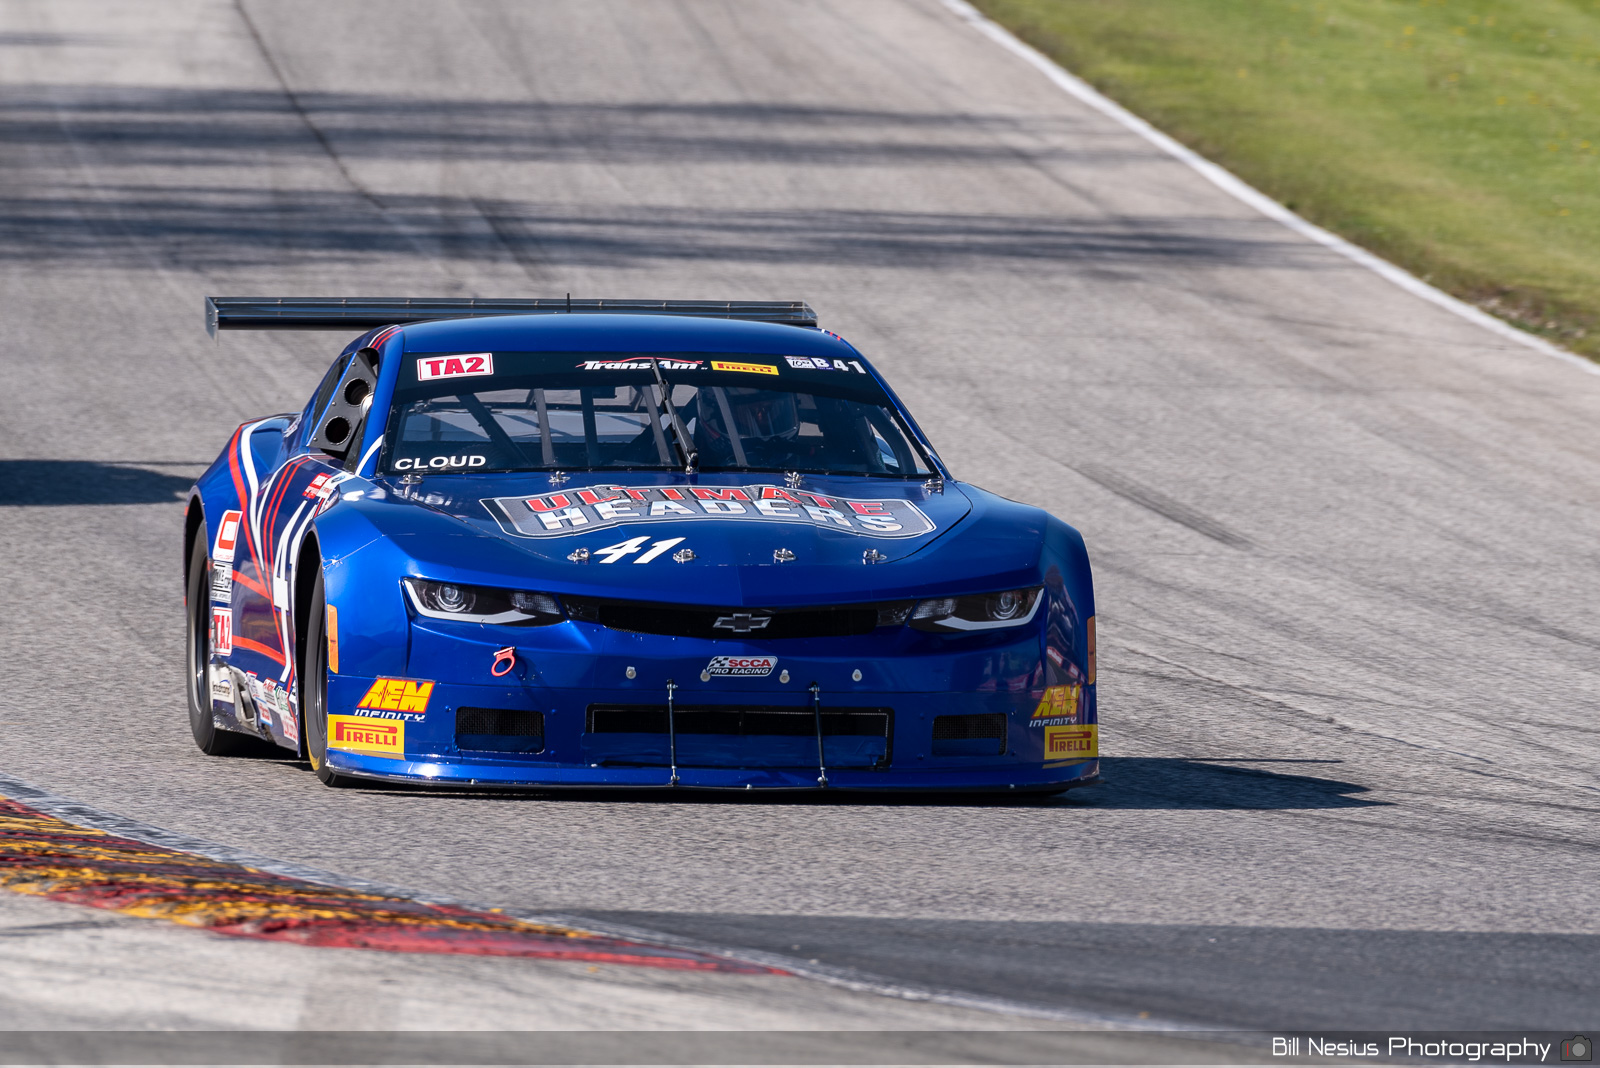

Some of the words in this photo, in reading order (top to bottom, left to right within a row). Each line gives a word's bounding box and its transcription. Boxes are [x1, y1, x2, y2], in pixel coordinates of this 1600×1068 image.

[425, 356, 485, 376] TA2
[833, 359, 867, 374] 41
[394, 455, 486, 470] CLOUD
[523, 485, 886, 516] ULTIMATE
[540, 499, 902, 533] HEADERS
[593, 536, 687, 564] 41
[728, 658, 772, 668] SCCA
[356, 677, 435, 713] AEM
[1031, 683, 1081, 719] AEM
[354, 708, 426, 722] INFINITY
[1028, 717, 1078, 728] INFINITY
[335, 722, 398, 746] PIRELLI
[1048, 730, 1092, 753] PIRELLI
